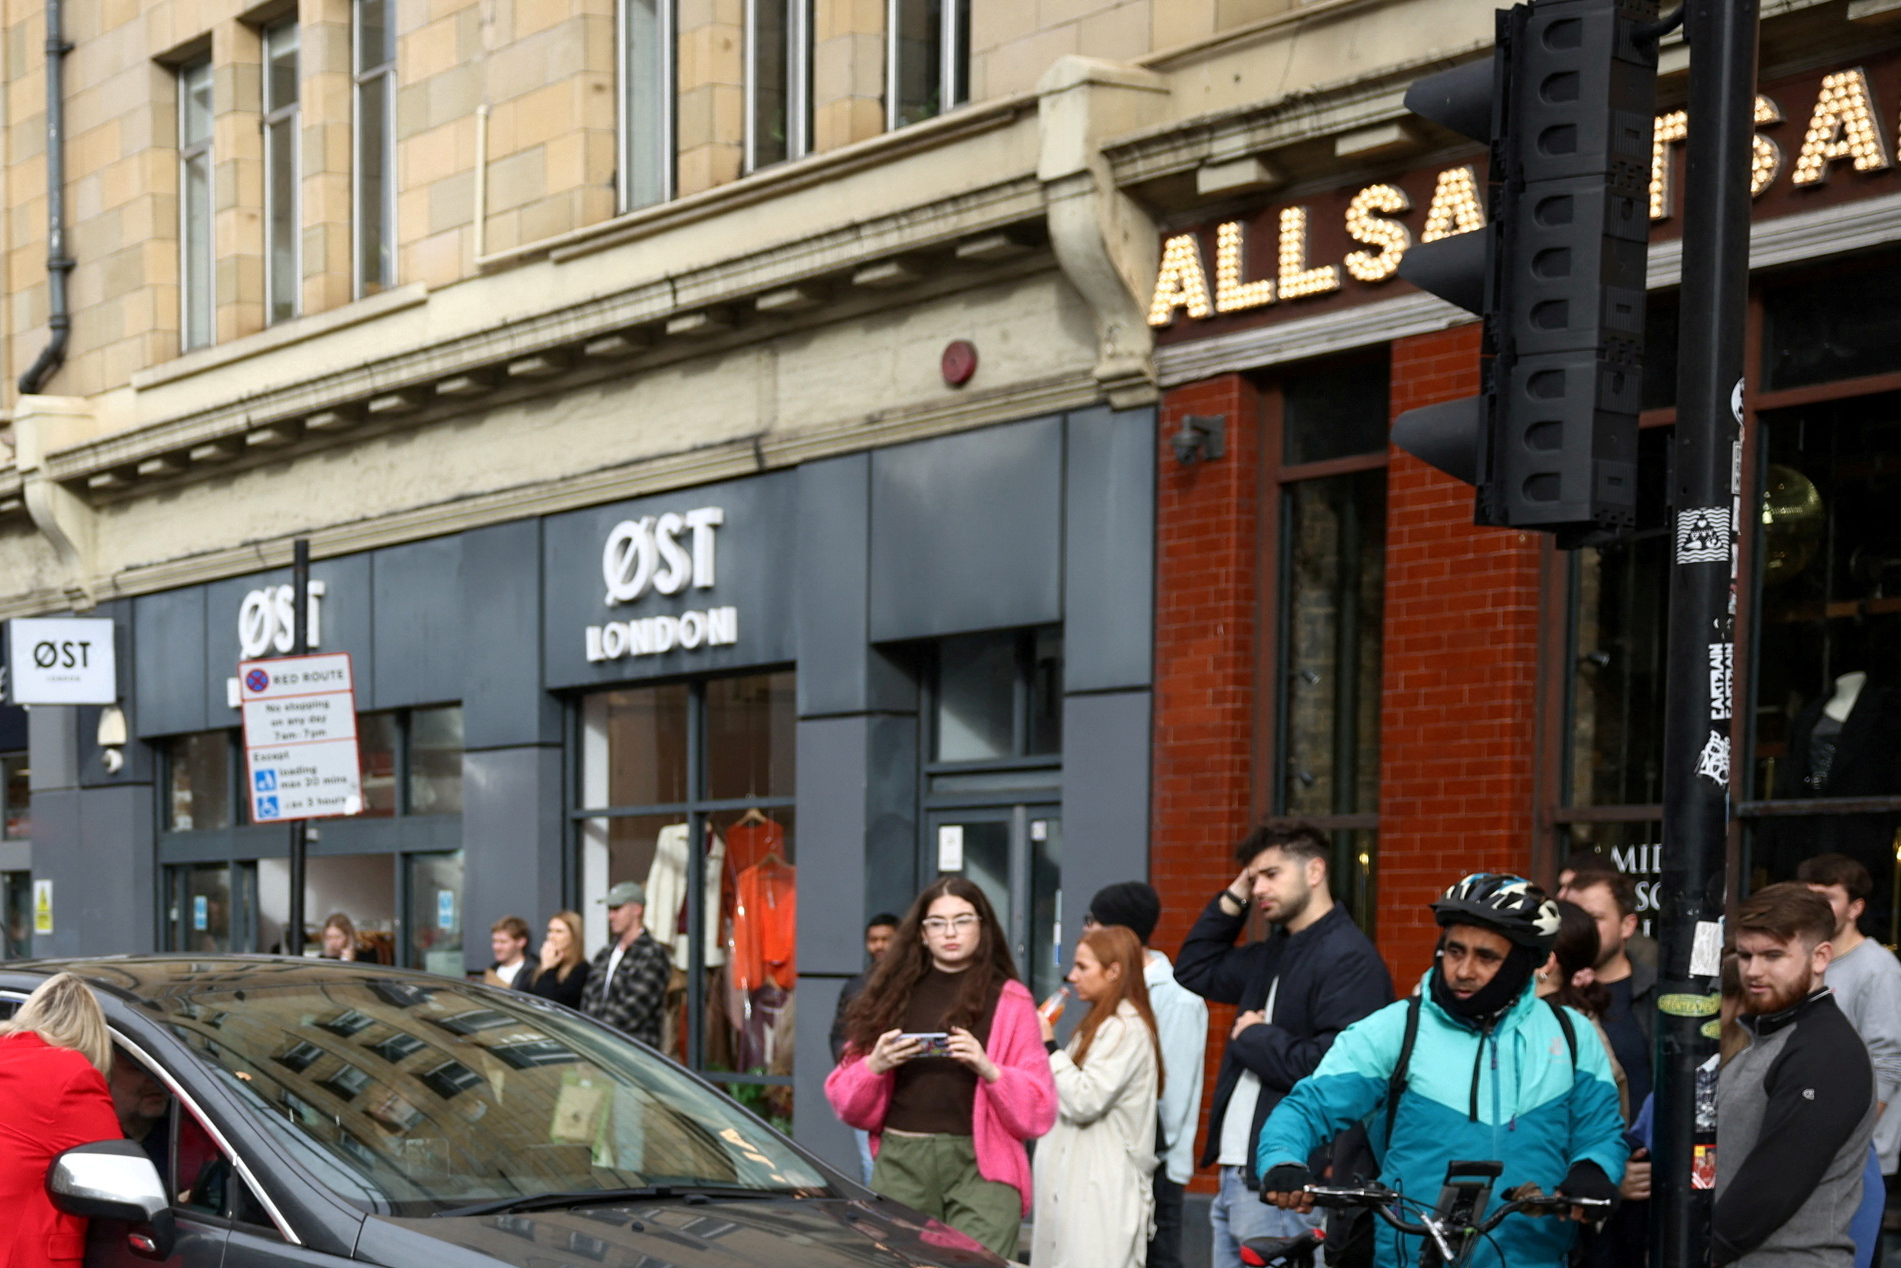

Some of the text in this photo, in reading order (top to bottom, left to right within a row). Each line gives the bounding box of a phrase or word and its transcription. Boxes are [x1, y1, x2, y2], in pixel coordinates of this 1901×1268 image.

[586, 606, 737, 661] LONDON
[34, 640, 91, 670] ØST
[273, 669, 344, 685] RED ROUTE
[266, 699, 331, 713] No stopping
